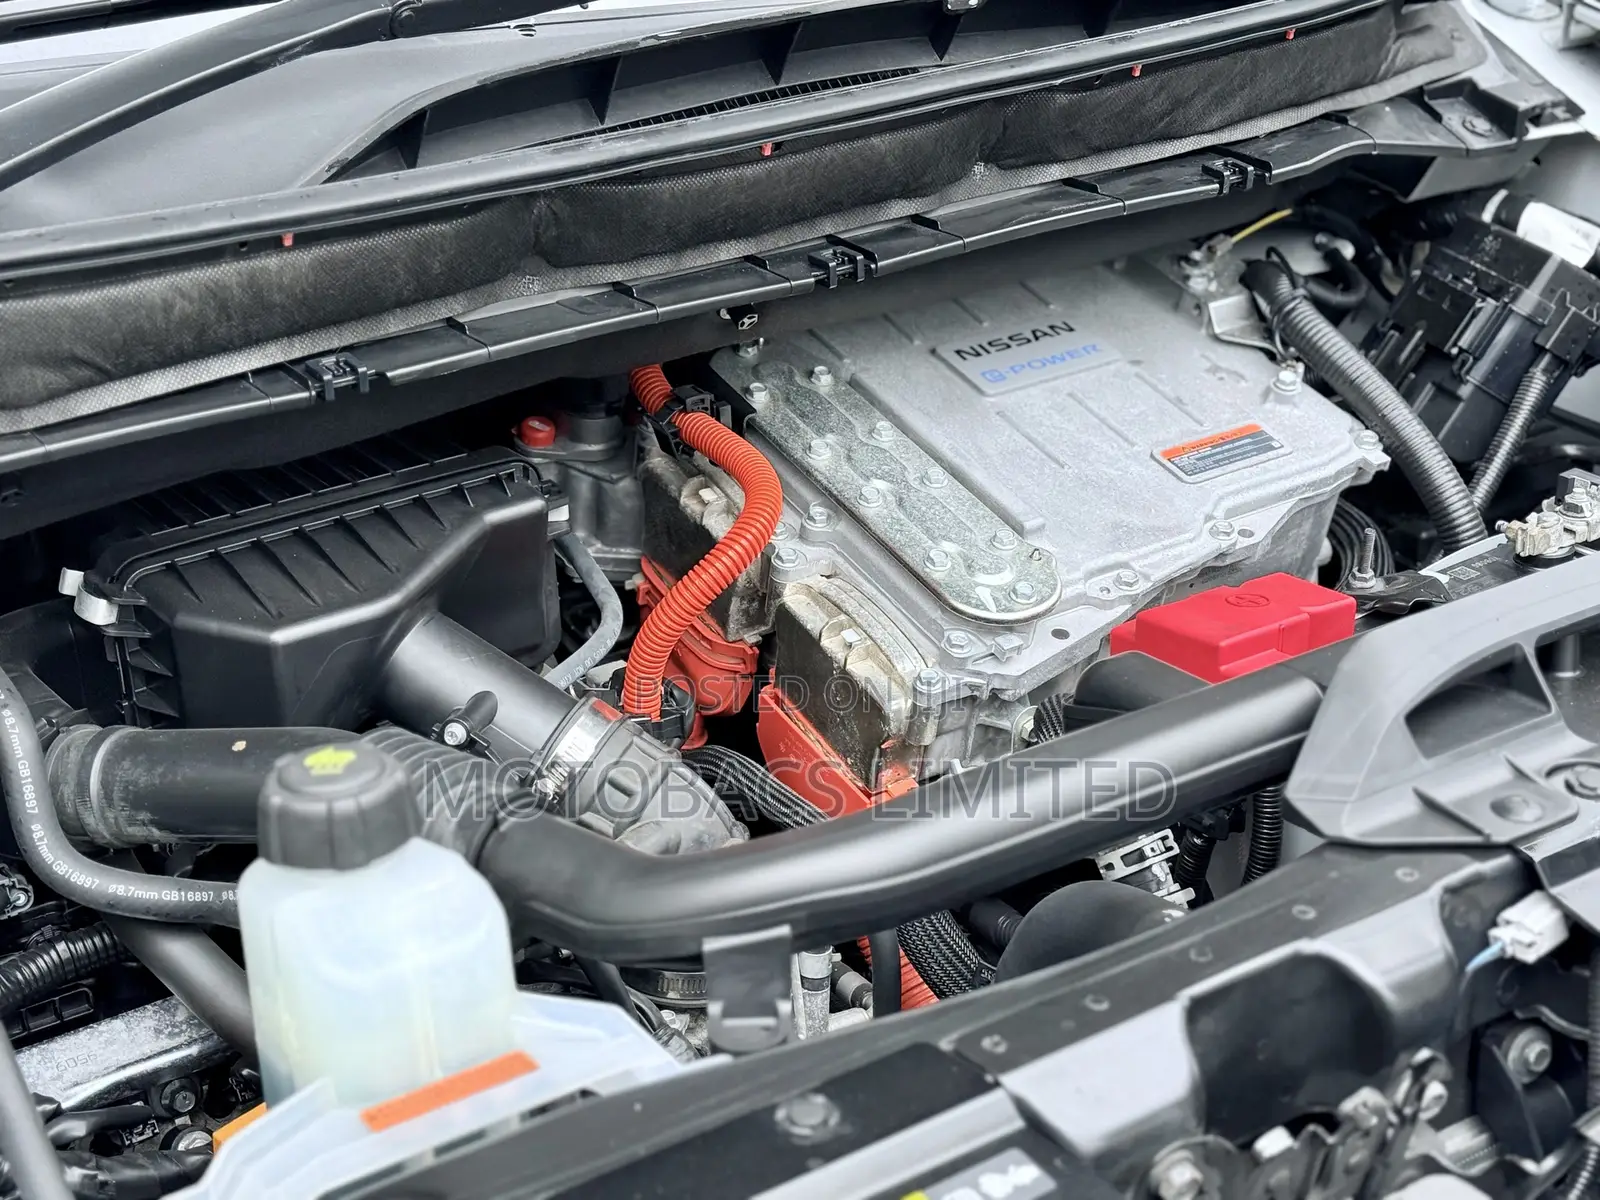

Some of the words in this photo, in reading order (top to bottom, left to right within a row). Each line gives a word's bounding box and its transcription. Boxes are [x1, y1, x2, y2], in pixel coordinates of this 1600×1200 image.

[954, 321, 1076, 361] NISSAN
[18, 760, 39, 815] GB16897
[52, 860, 100, 891] GB16897
[161, 890, 214, 902] GB16897
